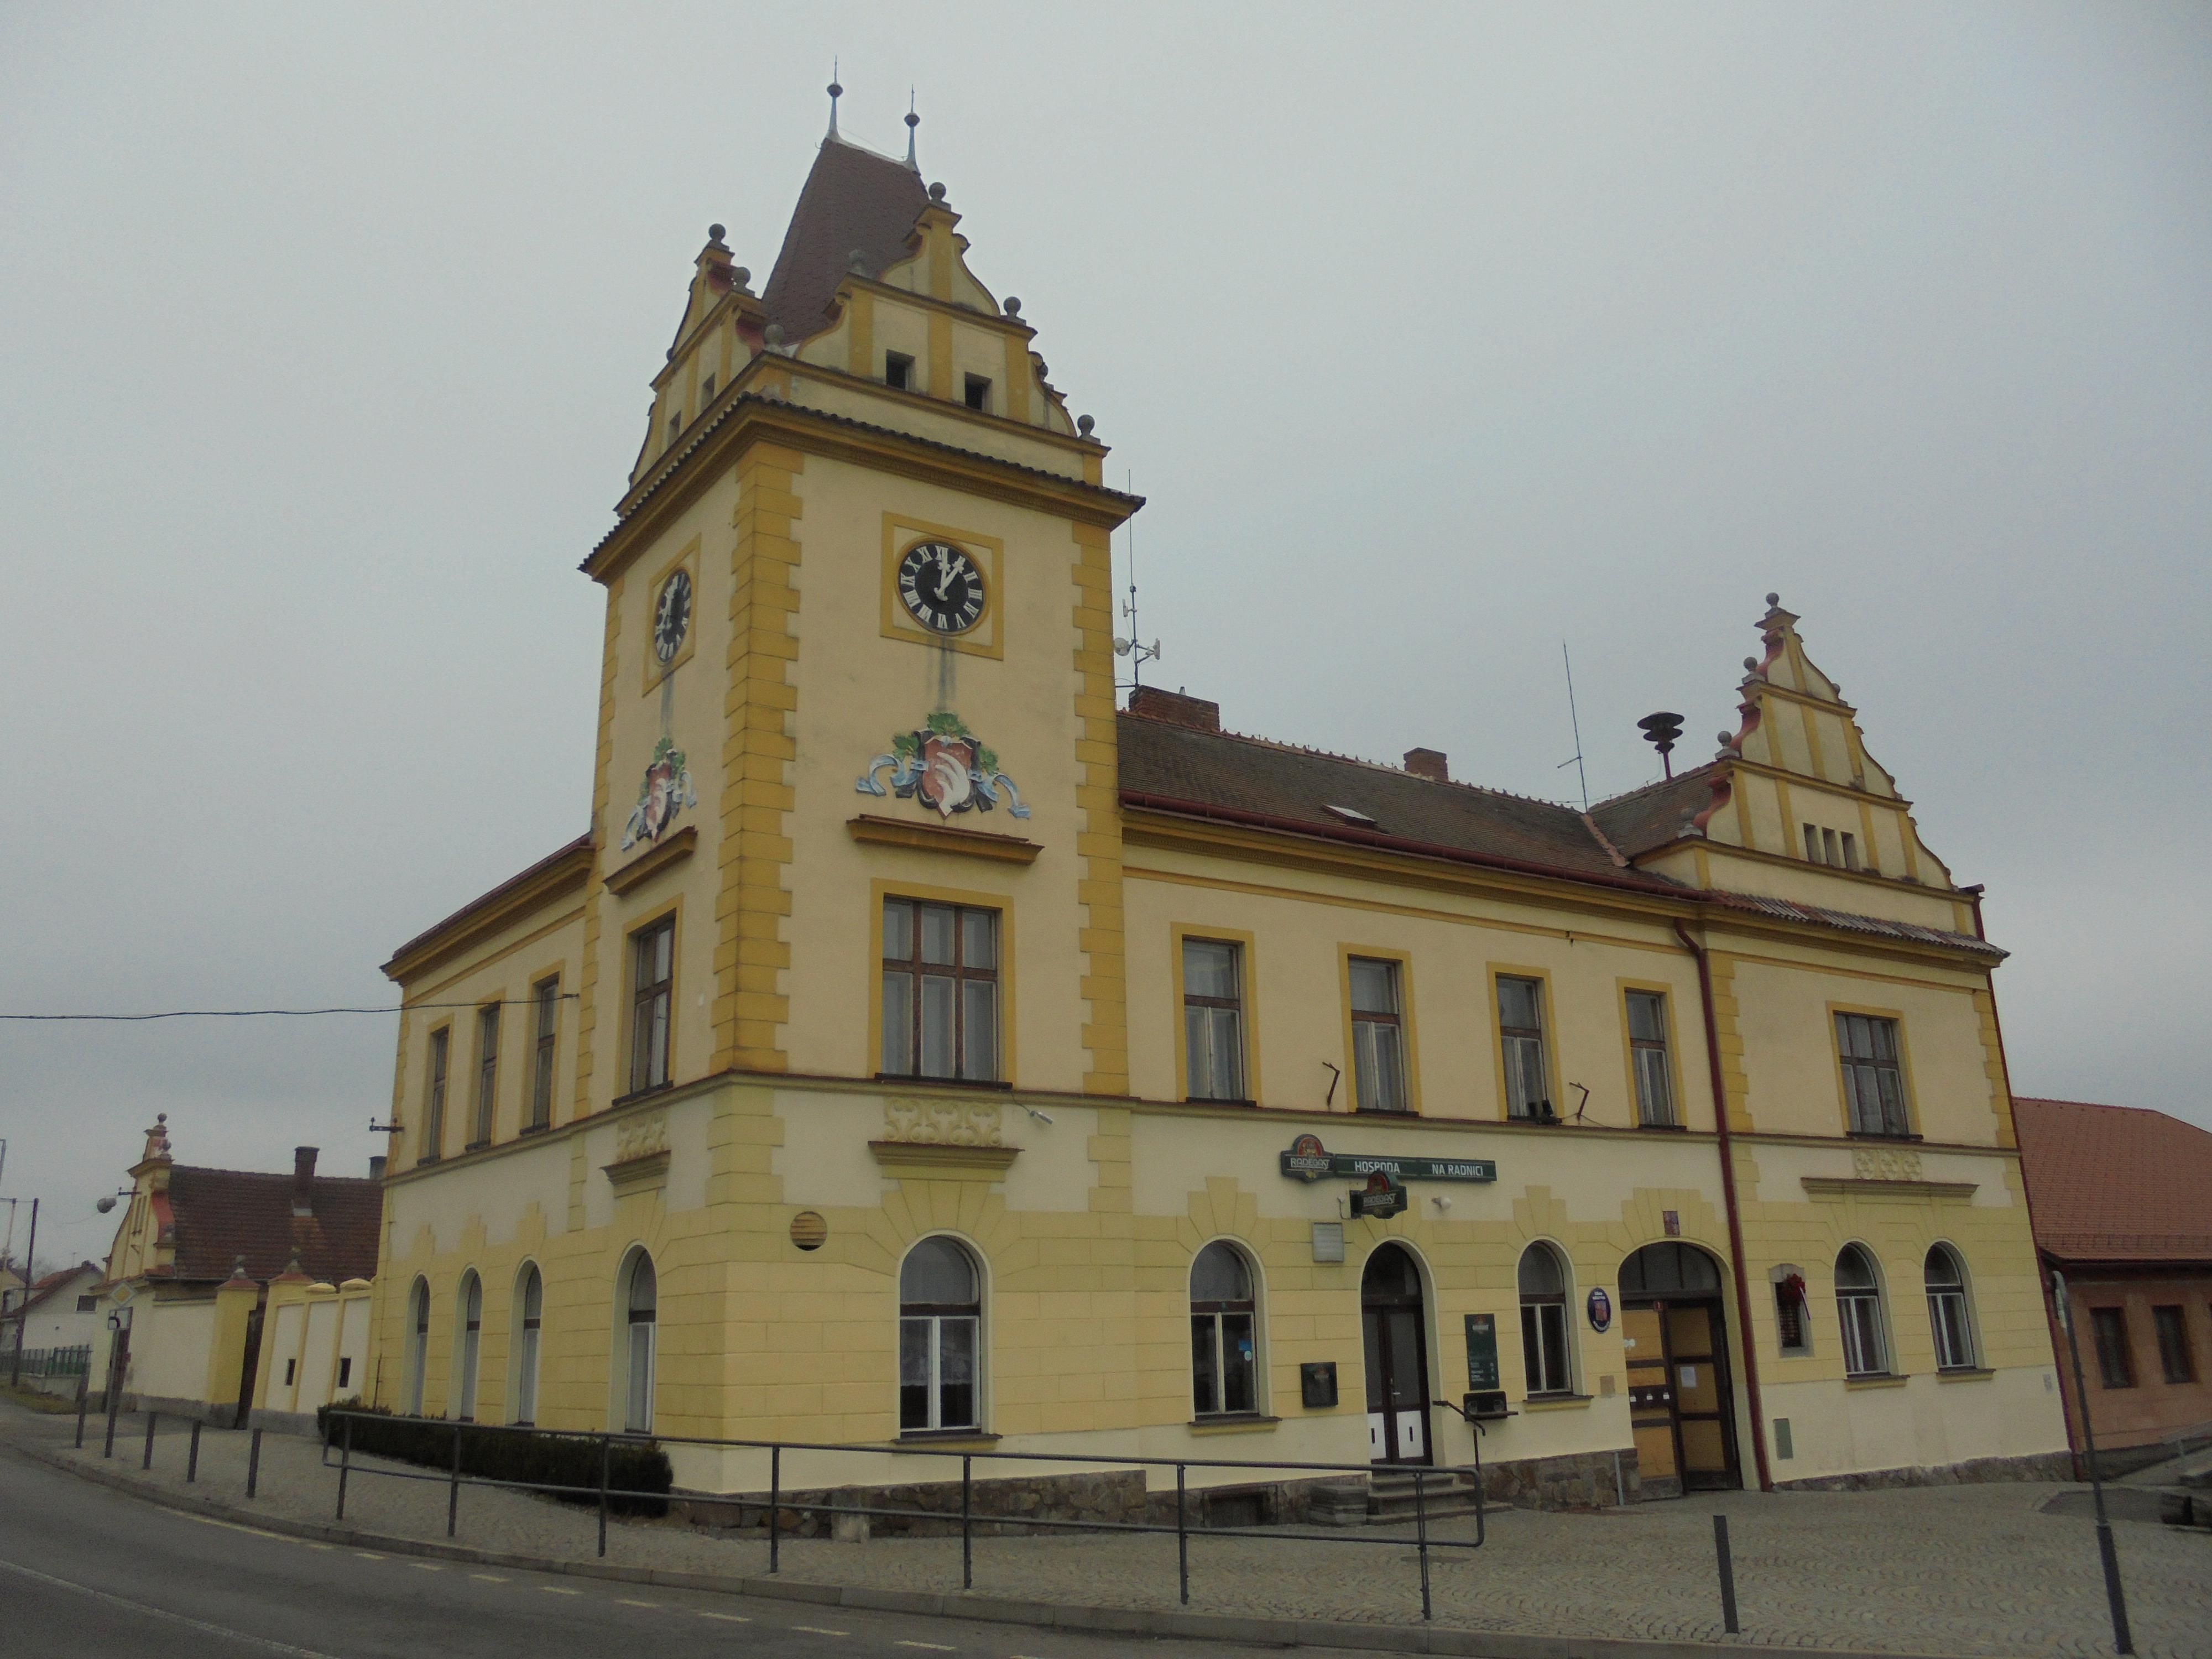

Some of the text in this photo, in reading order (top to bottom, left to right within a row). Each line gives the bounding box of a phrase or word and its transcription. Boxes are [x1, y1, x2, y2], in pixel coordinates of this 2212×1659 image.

[1290, 1157, 1330, 1170] RADEGAST
[1355, 1161, 1483, 1176] HOSPODA NA RADNICI
[1363, 1193, 1396, 1206] RADEGAST
